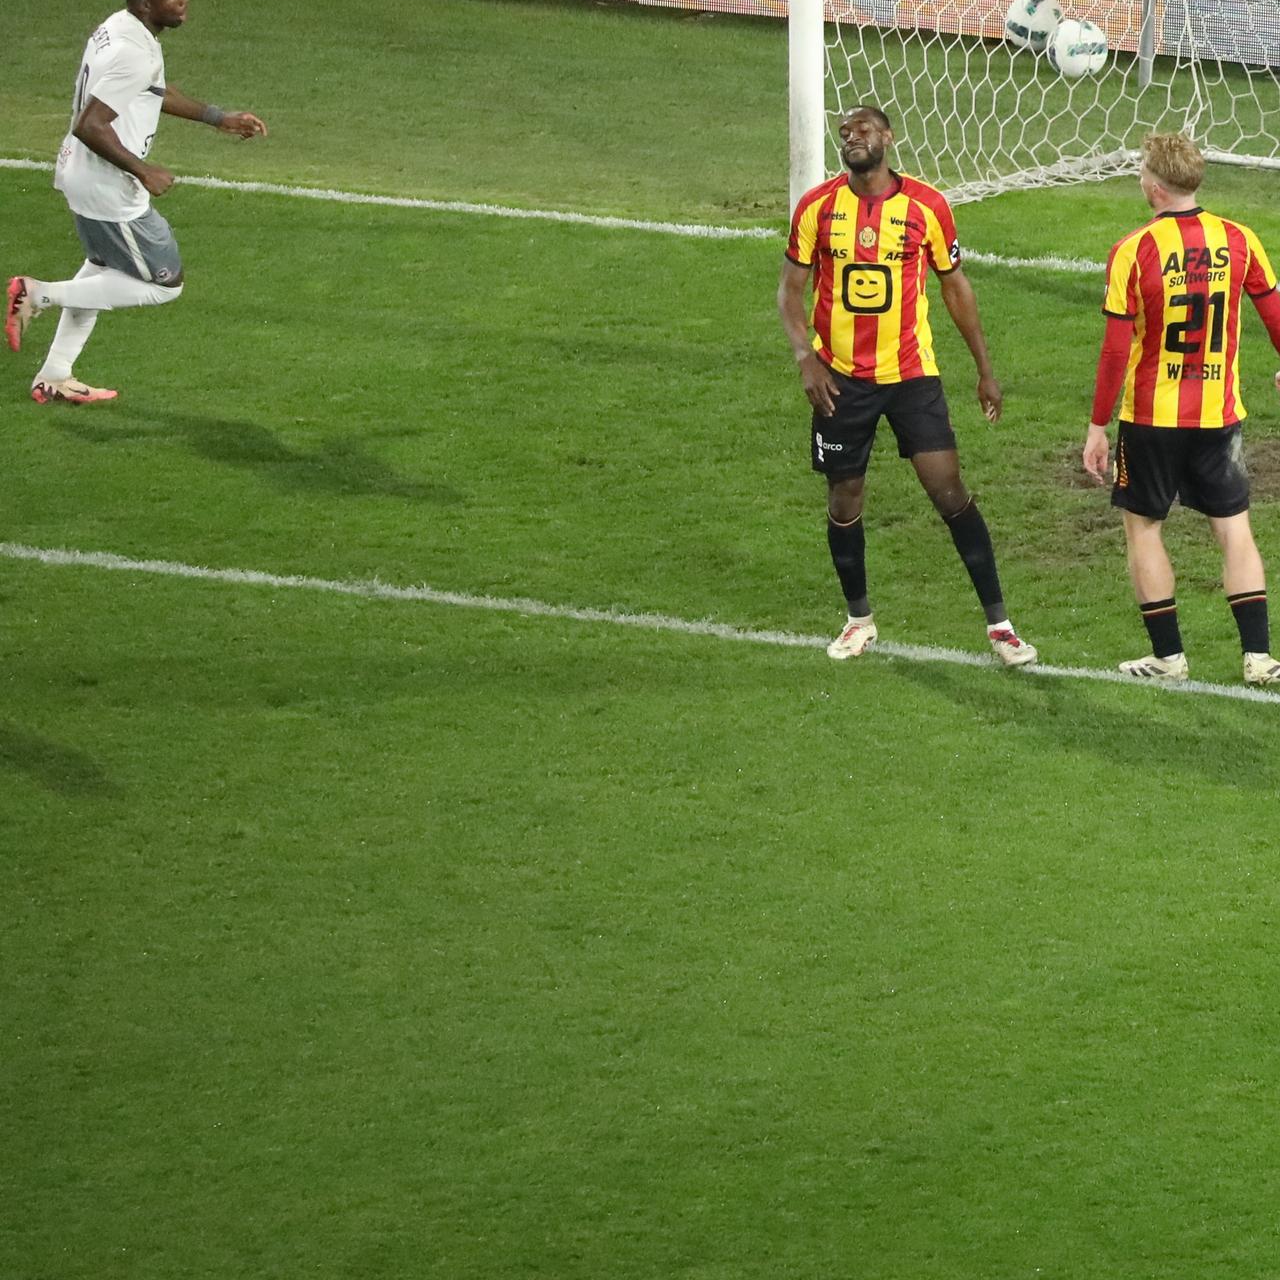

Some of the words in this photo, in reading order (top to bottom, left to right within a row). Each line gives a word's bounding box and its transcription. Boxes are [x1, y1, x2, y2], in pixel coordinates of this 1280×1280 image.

[1162, 247, 1230, 276] AFAS
[1169, 271, 1226, 288] software
[1165, 291, 1226, 354] 21
[1166, 363, 1222, 380] WELSH
